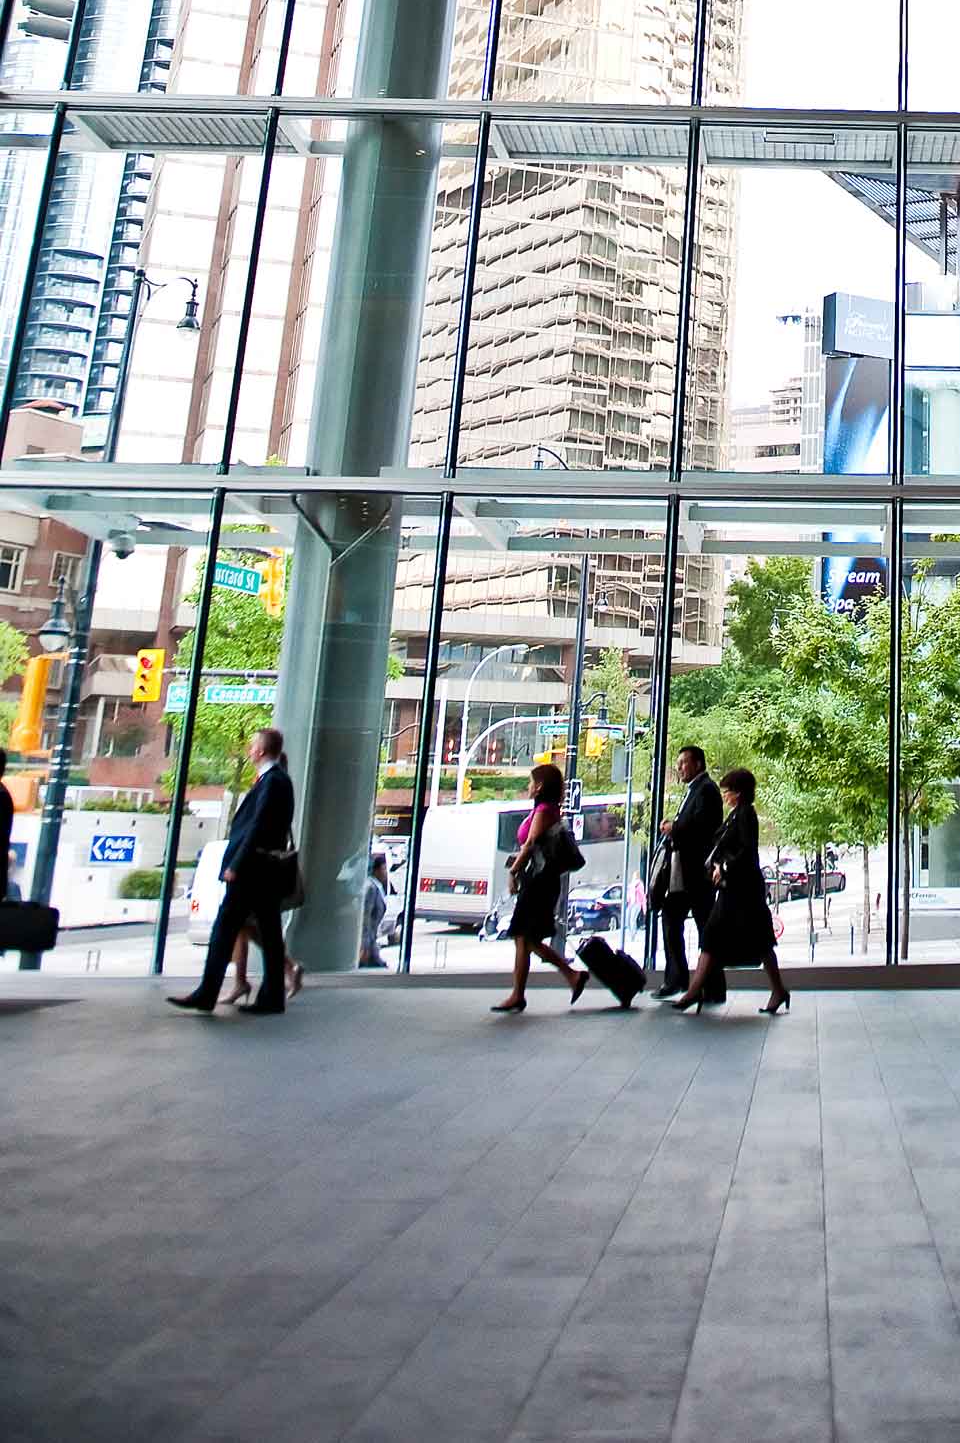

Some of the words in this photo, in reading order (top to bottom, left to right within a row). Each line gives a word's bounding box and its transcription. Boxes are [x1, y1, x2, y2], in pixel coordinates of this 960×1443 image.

[214, 567, 243, 586] urrard
[245, 572, 256, 590] St
[827, 598, 854, 613] Spa
[211, 687, 257, 701] Canada
[105, 837, 134, 849] Public
[104, 849, 126, 860] Park
